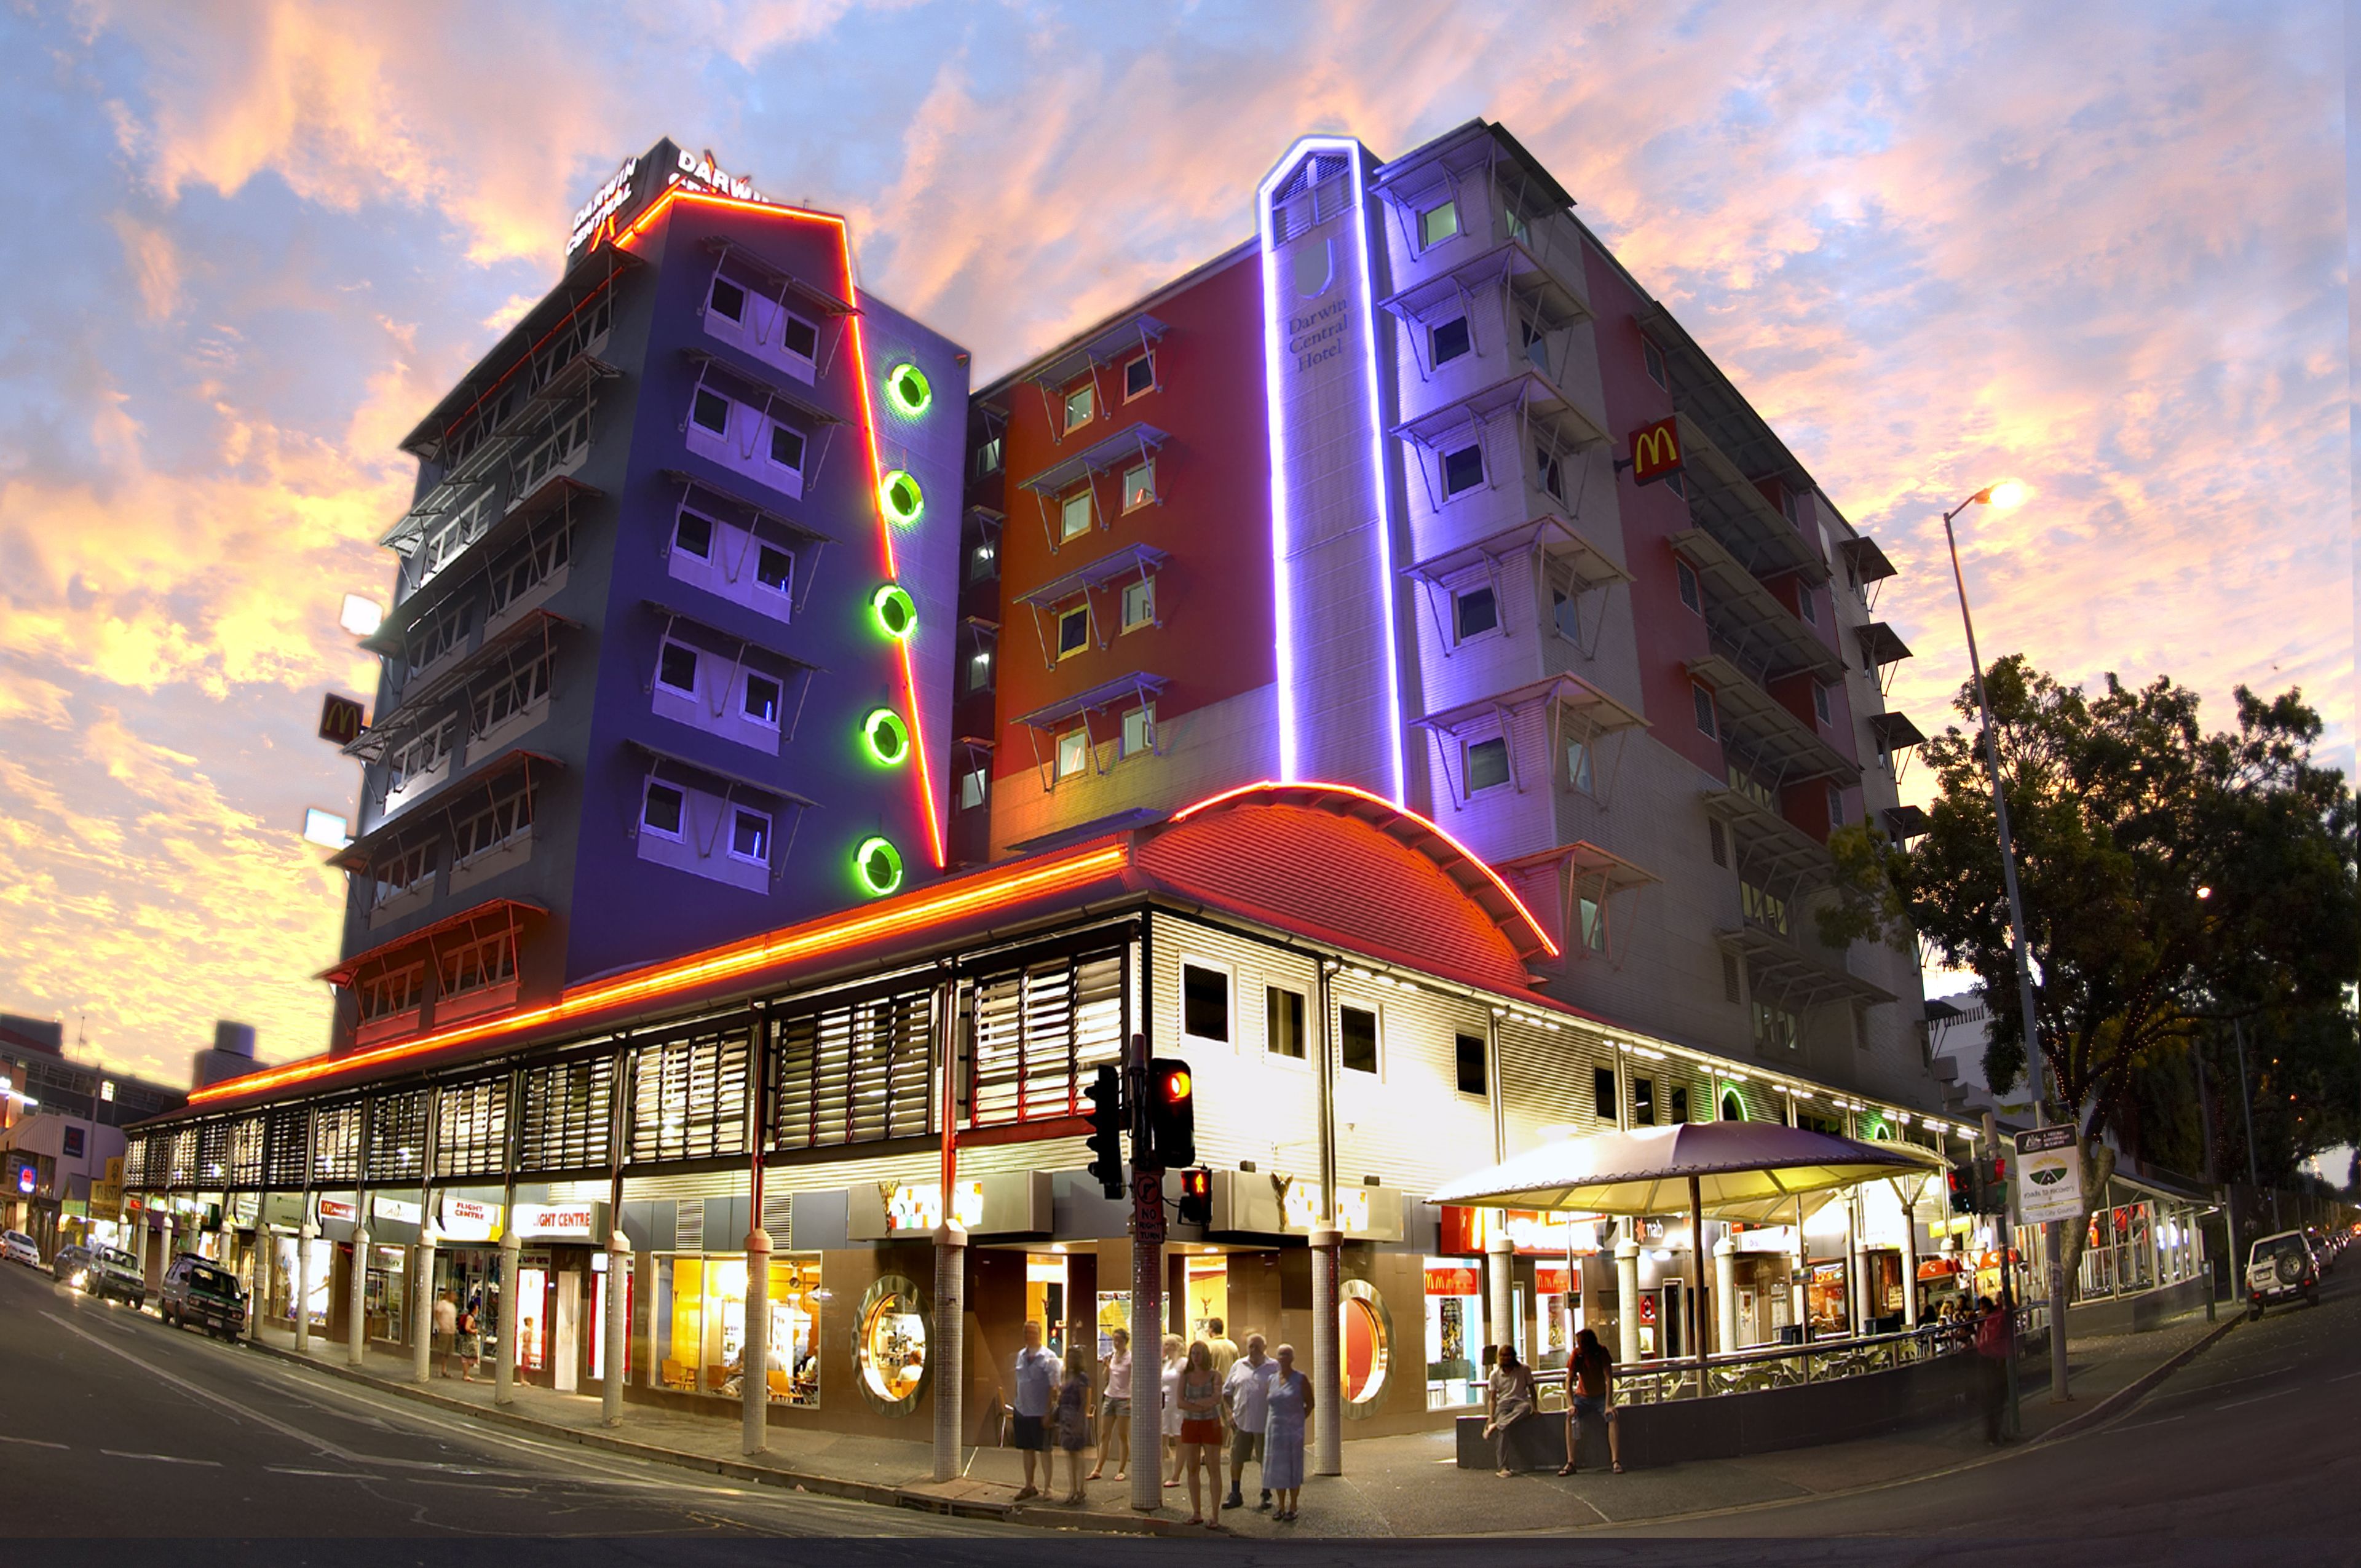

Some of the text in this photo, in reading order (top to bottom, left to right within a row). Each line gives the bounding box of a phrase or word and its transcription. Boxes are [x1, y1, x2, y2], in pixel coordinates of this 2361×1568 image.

[1289, 299, 1347, 335] Darwin
[1289, 313, 1348, 354] Central
[1298, 338, 1342, 373] Hotel
[454, 1210, 484, 1220] CENTRE
[456, 1202, 483, 1212] FLIGHT
[1141, 1208, 1157, 1219] NO
[558, 1212, 590, 1227] CENTRE
[1646, 1219, 1663, 1238] nab
